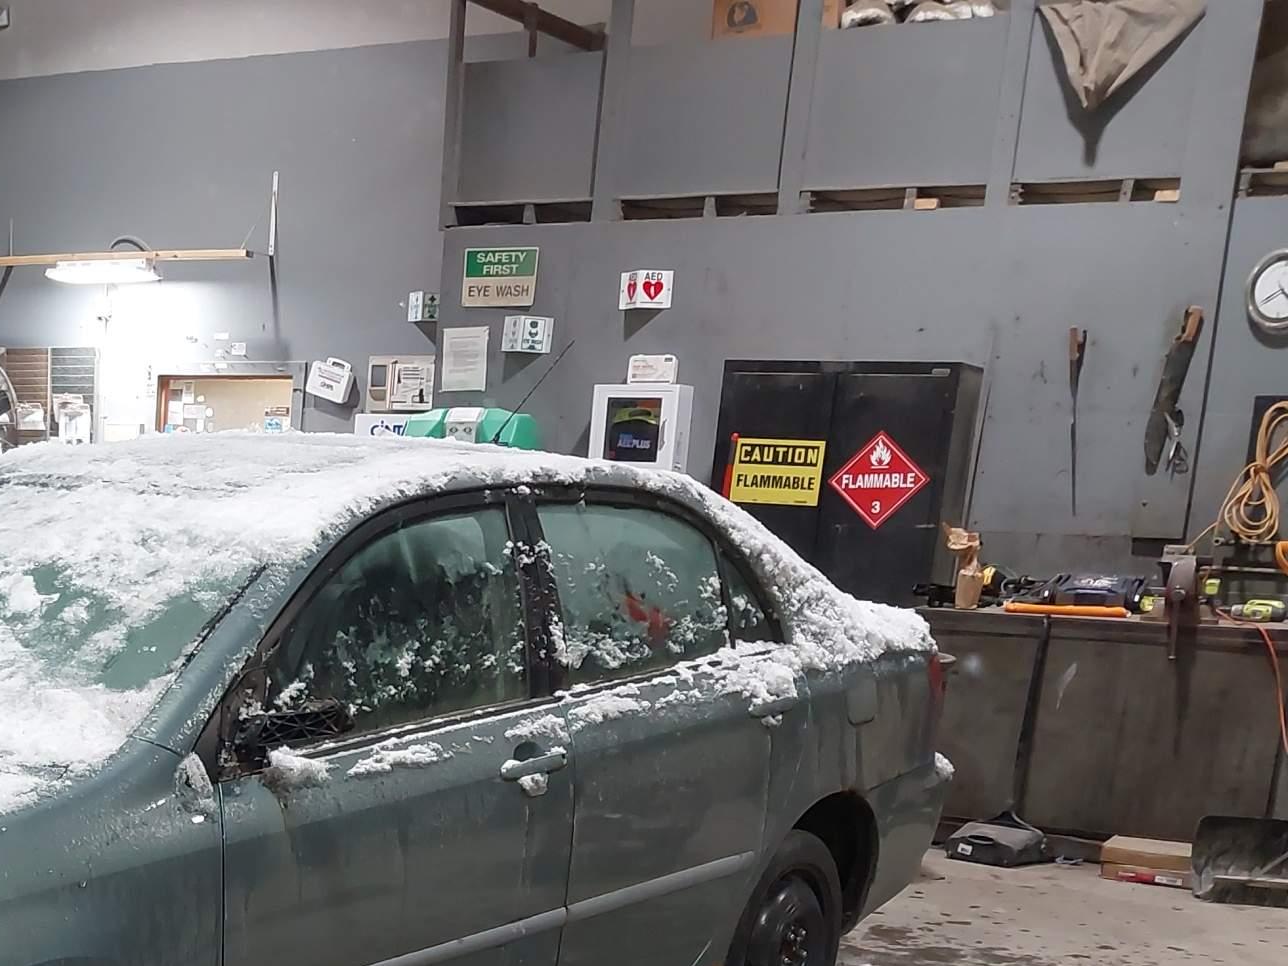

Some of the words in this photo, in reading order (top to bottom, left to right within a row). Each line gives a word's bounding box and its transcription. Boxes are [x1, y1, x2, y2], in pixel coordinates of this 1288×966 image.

[476, 251, 527, 263] SAFETY
[482, 264, 519, 275] FIRST
[644, 271, 663, 281] AED
[467, 285, 492, 297] EYE
[495, 284, 530, 298] WASH
[740, 445, 818, 464] CAUTION
[736, 473, 816, 491] FLAMMABLE
[841, 473, 915, 489] FLAMMABLE
[871, 500, 881, 514] 3
